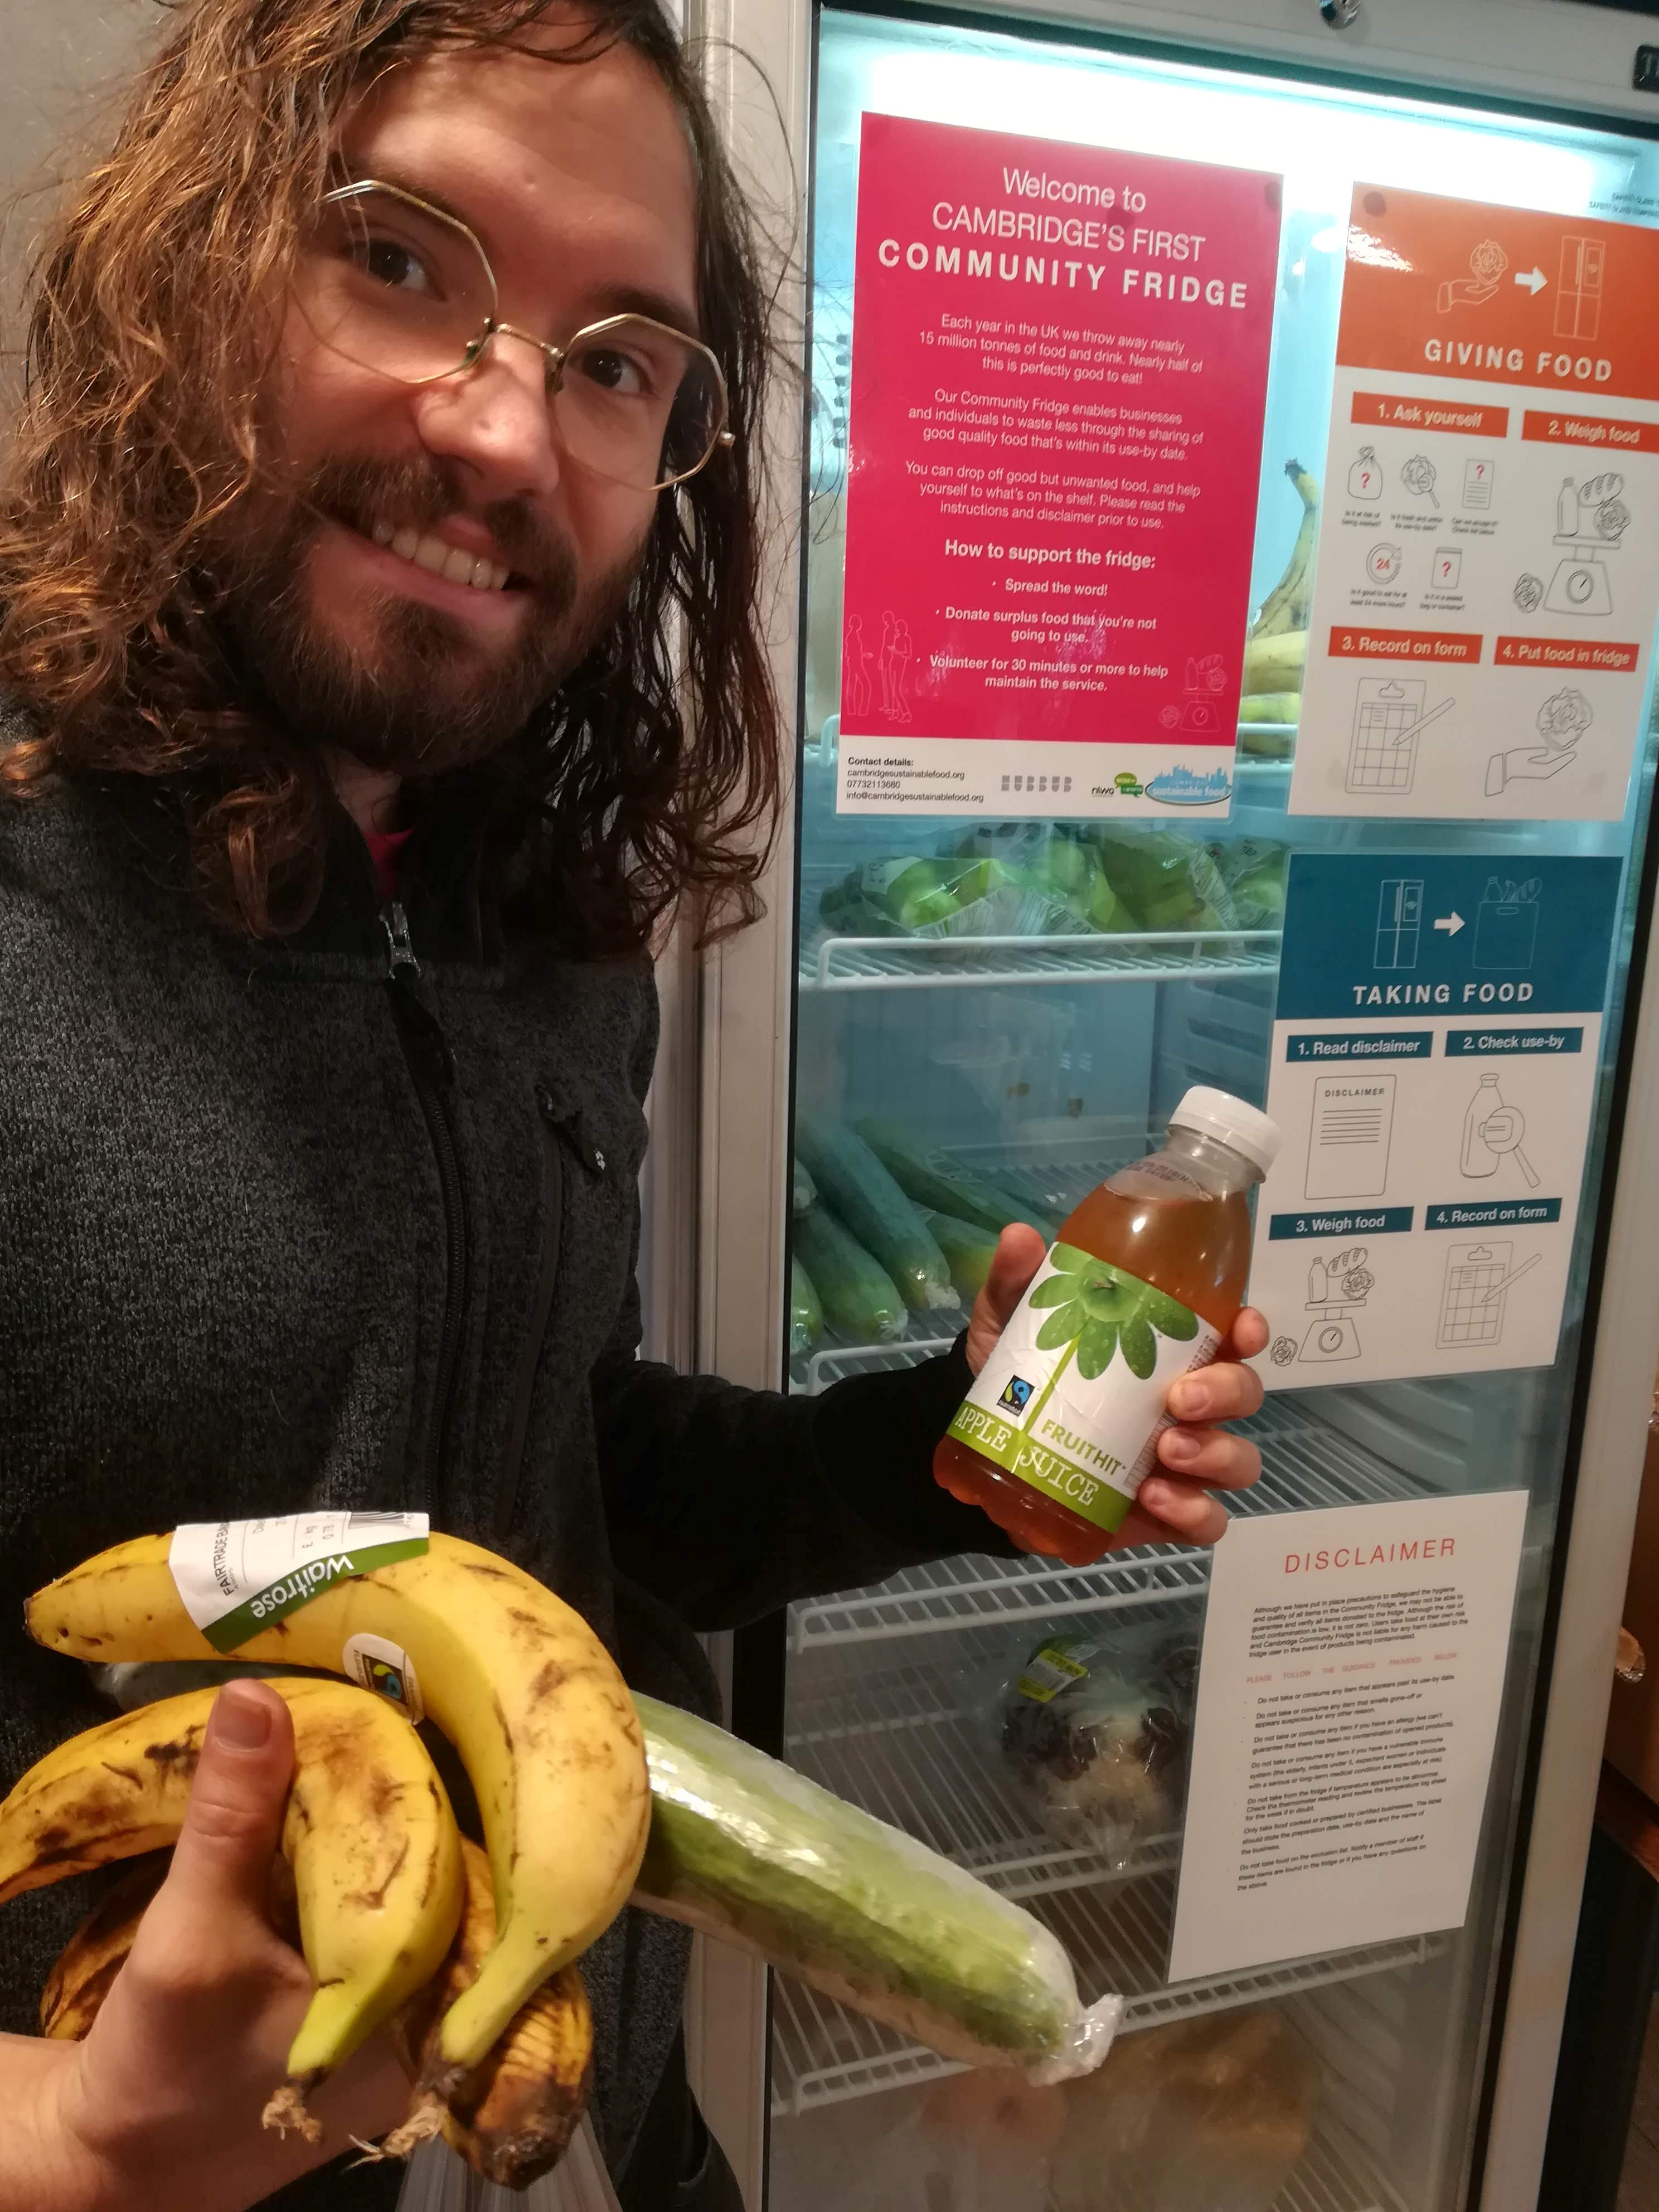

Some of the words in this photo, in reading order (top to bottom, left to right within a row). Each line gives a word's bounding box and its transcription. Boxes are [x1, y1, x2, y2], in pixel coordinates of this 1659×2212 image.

[1003, 167, 1115, 208] Welcome
[1123, 186, 1146, 212] to
[933, 202, 1124, 252] CAMBRIDGE'S
[1133, 228, 1206, 262] FIRST
[879, 239, 1106, 290] COMMUNITY
[1123, 269, 1247, 308] FRIDGE
[942, 313, 972, 330] Each
[976, 321, 1002, 333] year
[1005, 321, 1015, 335] in
[1019, 323, 1038, 337] the
[1041, 324, 1060, 339] UK
[1063, 329, 1080, 342] we
[1083, 329, 1115, 346] throw
[1118, 336, 1148, 352] away
[1151, 340, 1185, 356] nearly
[920, 331, 934, 345] 15
[938, 333, 977, 350] million
[980, 337, 1021, 354] tonnes
[1024, 342, 1037, 355] of
[1039, 342, 1066, 358] food
[1069, 348, 1092, 361] and
[1129, 352, 1166, 372] Nearly
[1168, 357, 1189, 371] half
[1191, 360, 1203, 373] of
[1425, 339, 1524, 371] GIVING
[1537, 352, 1612, 381] FOOD
[982, 356, 1004, 371] this
[1007, 358, 1017, 372] is
[1020, 361, 1071, 380] perfectly
[1074, 368, 1104, 381] good
[1107, 369, 1119, 383] to
[1121, 372, 1143, 384] eat!
[934, 389, 958, 403] Our
[961, 391, 1030, 413] Community
[1032, 397, 1070, 416] Fridge
[1072, 404, 1117, 419] enables
[1119, 406, 1182, 425] businesses
[1378, 403, 1390, 419] 1.
[1393, 404, 1422, 422] Ask
[1424, 411, 1483, 428] yourself
[1548, 420, 1561, 435] 2.
[1565, 421, 1606, 443] Weigh
[1609, 426, 1641, 444] food
[905, 460, 928, 476] You
[931, 465, 954, 477] can
[957, 465, 985, 482] drop
[988, 467, 1004, 481] off
[1006, 470, 1037, 484] good
[1040, 472, 1059, 486] but
[1063, 476, 1118, 490] unwanted
[1152, 483, 1174, 495] and
[1177, 483, 1201, 499] help
[920, 483, 968, 496] yourself
[971, 484, 983, 498] to
[986, 486, 1024, 501] what's
[1026, 492, 1042, 502] on
[1045, 490, 1064, 504] the
[1099, 494, 1137, 509] Please
[1139, 499, 1165, 512] read
[1167, 500, 1186, 513] the
[940, 501, 1009, 518] instructions
[1012, 507, 1035, 520] and
[1036, 508, 1096, 524] disclaimer
[1098, 515, 1124, 527] prior
[1127, 515, 1138, 527] to
[1141, 517, 1164, 529] use.
[945, 539, 983, 557] How
[987, 543, 1004, 559] to
[1008, 547, 1072, 565] support
[1076, 549, 1102, 565] the
[1105, 550, 1156, 571] fridge:
[1376, 558, 1390, 570] 24
[1005, 578, 1049, 594] Spread
[1052, 581, 1071, 594] the
[1074, 584, 1108, 596] word!
[945, 607, 991, 621] Donate
[993, 610, 1039, 625] surplus
[1041, 612, 1069, 625] food
[1072, 613, 1095, 626] that
[1097, 615, 1135, 630] you're
[1137, 618, 1157, 629] not
[1011, 628, 1045, 644] going
[1049, 630, 1061, 642] to
[1063, 630, 1089, 646] use.
[1342, 636, 1355, 651] 3.
[1359, 637, 1411, 654] Record
[1413, 643, 1432, 655] on
[1434, 641, 1467, 657] form
[930, 653, 989, 671] Volunteer
[992, 658, 1009, 670] for
[1012, 658, 1027, 671] 30
[1029, 660, 1077, 673] minutes
[1080, 664, 1093, 673] or
[1095, 664, 1126, 675] more
[1128, 664, 1141, 676] to
[1143, 664, 1168, 680] help
[1502, 644, 1515, 658] 4.
[1518, 644, 1542, 659] Put
[1544, 646, 1576, 662] food
[1576, 648, 1590, 663] in
[1592, 649, 1631, 667] fridge
[985, 675, 1037, 688] maintain
[1040, 677, 1059, 690] the
[1063, 678, 1107, 691] service.
[848, 756, 881, 765] Contact
[847, 769, 965, 781] cambridgesustainablefood.org
[846, 792, 984, 804] info@cambridgesustainablefood.org
[1353, 984, 1450, 1005] TAKING
[1463, 983, 1533, 1003] FOOD
[1298, 1042, 1310, 1055] 1.
[1313, 1041, 1349, 1055] Read
[1351, 1039, 1421, 1054] disclaimer
[1463, 1037, 1475, 1050] 2.
[1478, 1035, 1519, 1050] Check
[1521, 1034, 1565, 1050] use-by
[1325, 1088, 1385, 1098] DISCLAIMER
[1296, 1220, 1308, 1233] 3.
[1312, 1217, 1352, 1233] Weigh
[1355, 1215, 1386, 1229] food
[1437, 1211, 1448, 1224] 4.
[1451, 1208, 1498, 1223] Record
[1500, 1210, 1516, 1220] on
[1518, 1206, 1548, 1219] form
[955, 1406, 1013, 1453] APPLE
[1019, 1445, 1099, 1506] JUICE
[1041, 1419, 1122, 1476] FRUITHIT
[213, 1537, 234, 1596] FAIRTRADE
[1285, 1538, 1454, 1573] DISCLAIMER
[250, 1555, 354, 1618] Waitrose
